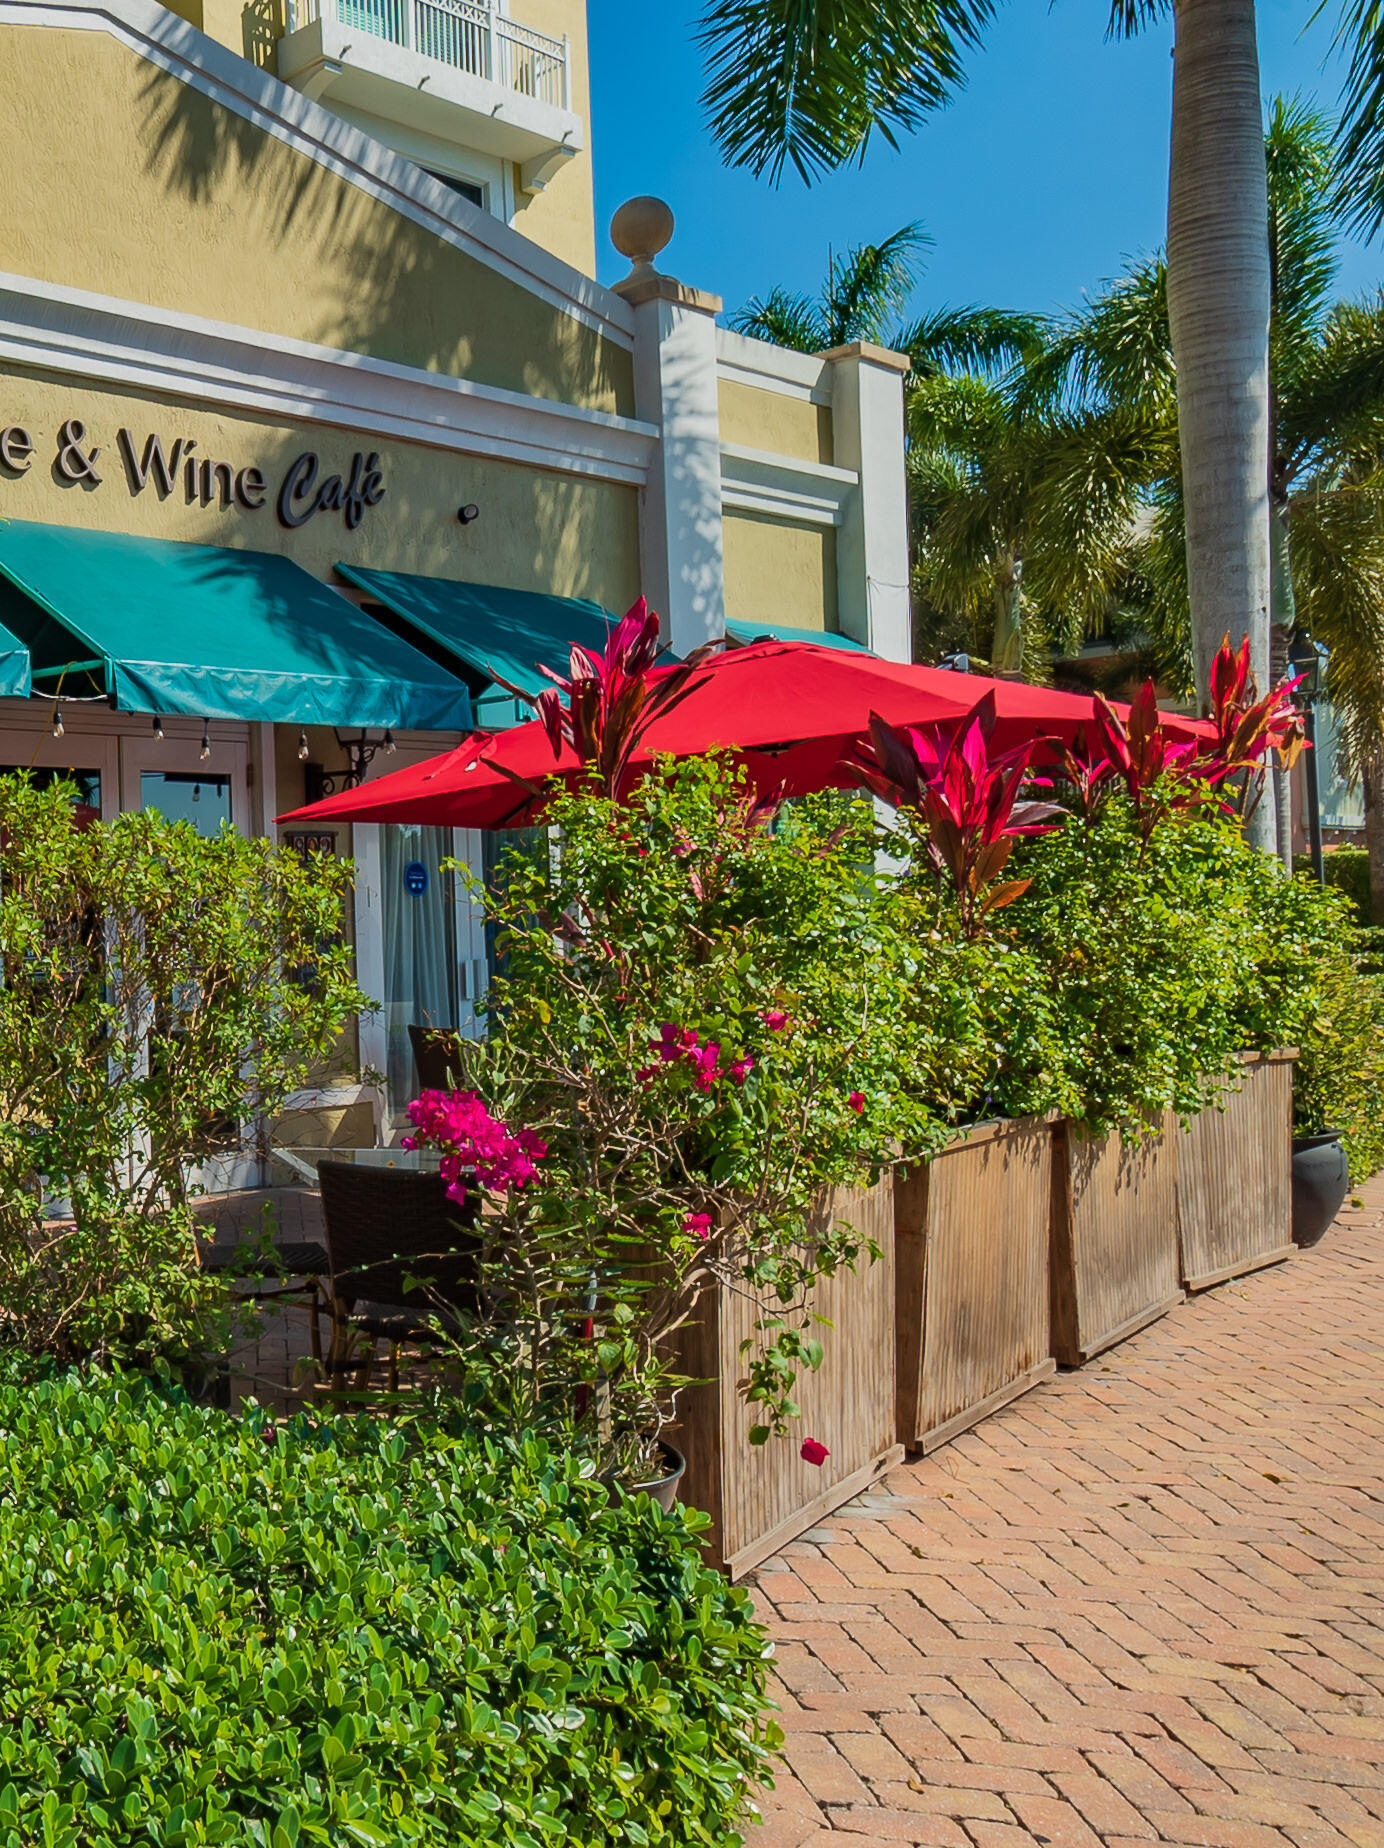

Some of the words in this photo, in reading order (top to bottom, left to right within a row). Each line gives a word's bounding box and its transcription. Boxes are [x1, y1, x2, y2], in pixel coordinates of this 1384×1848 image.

[56, 418, 103, 484] &
[117, 427, 267, 508] Wine
[277, 451, 386, 529] Café
